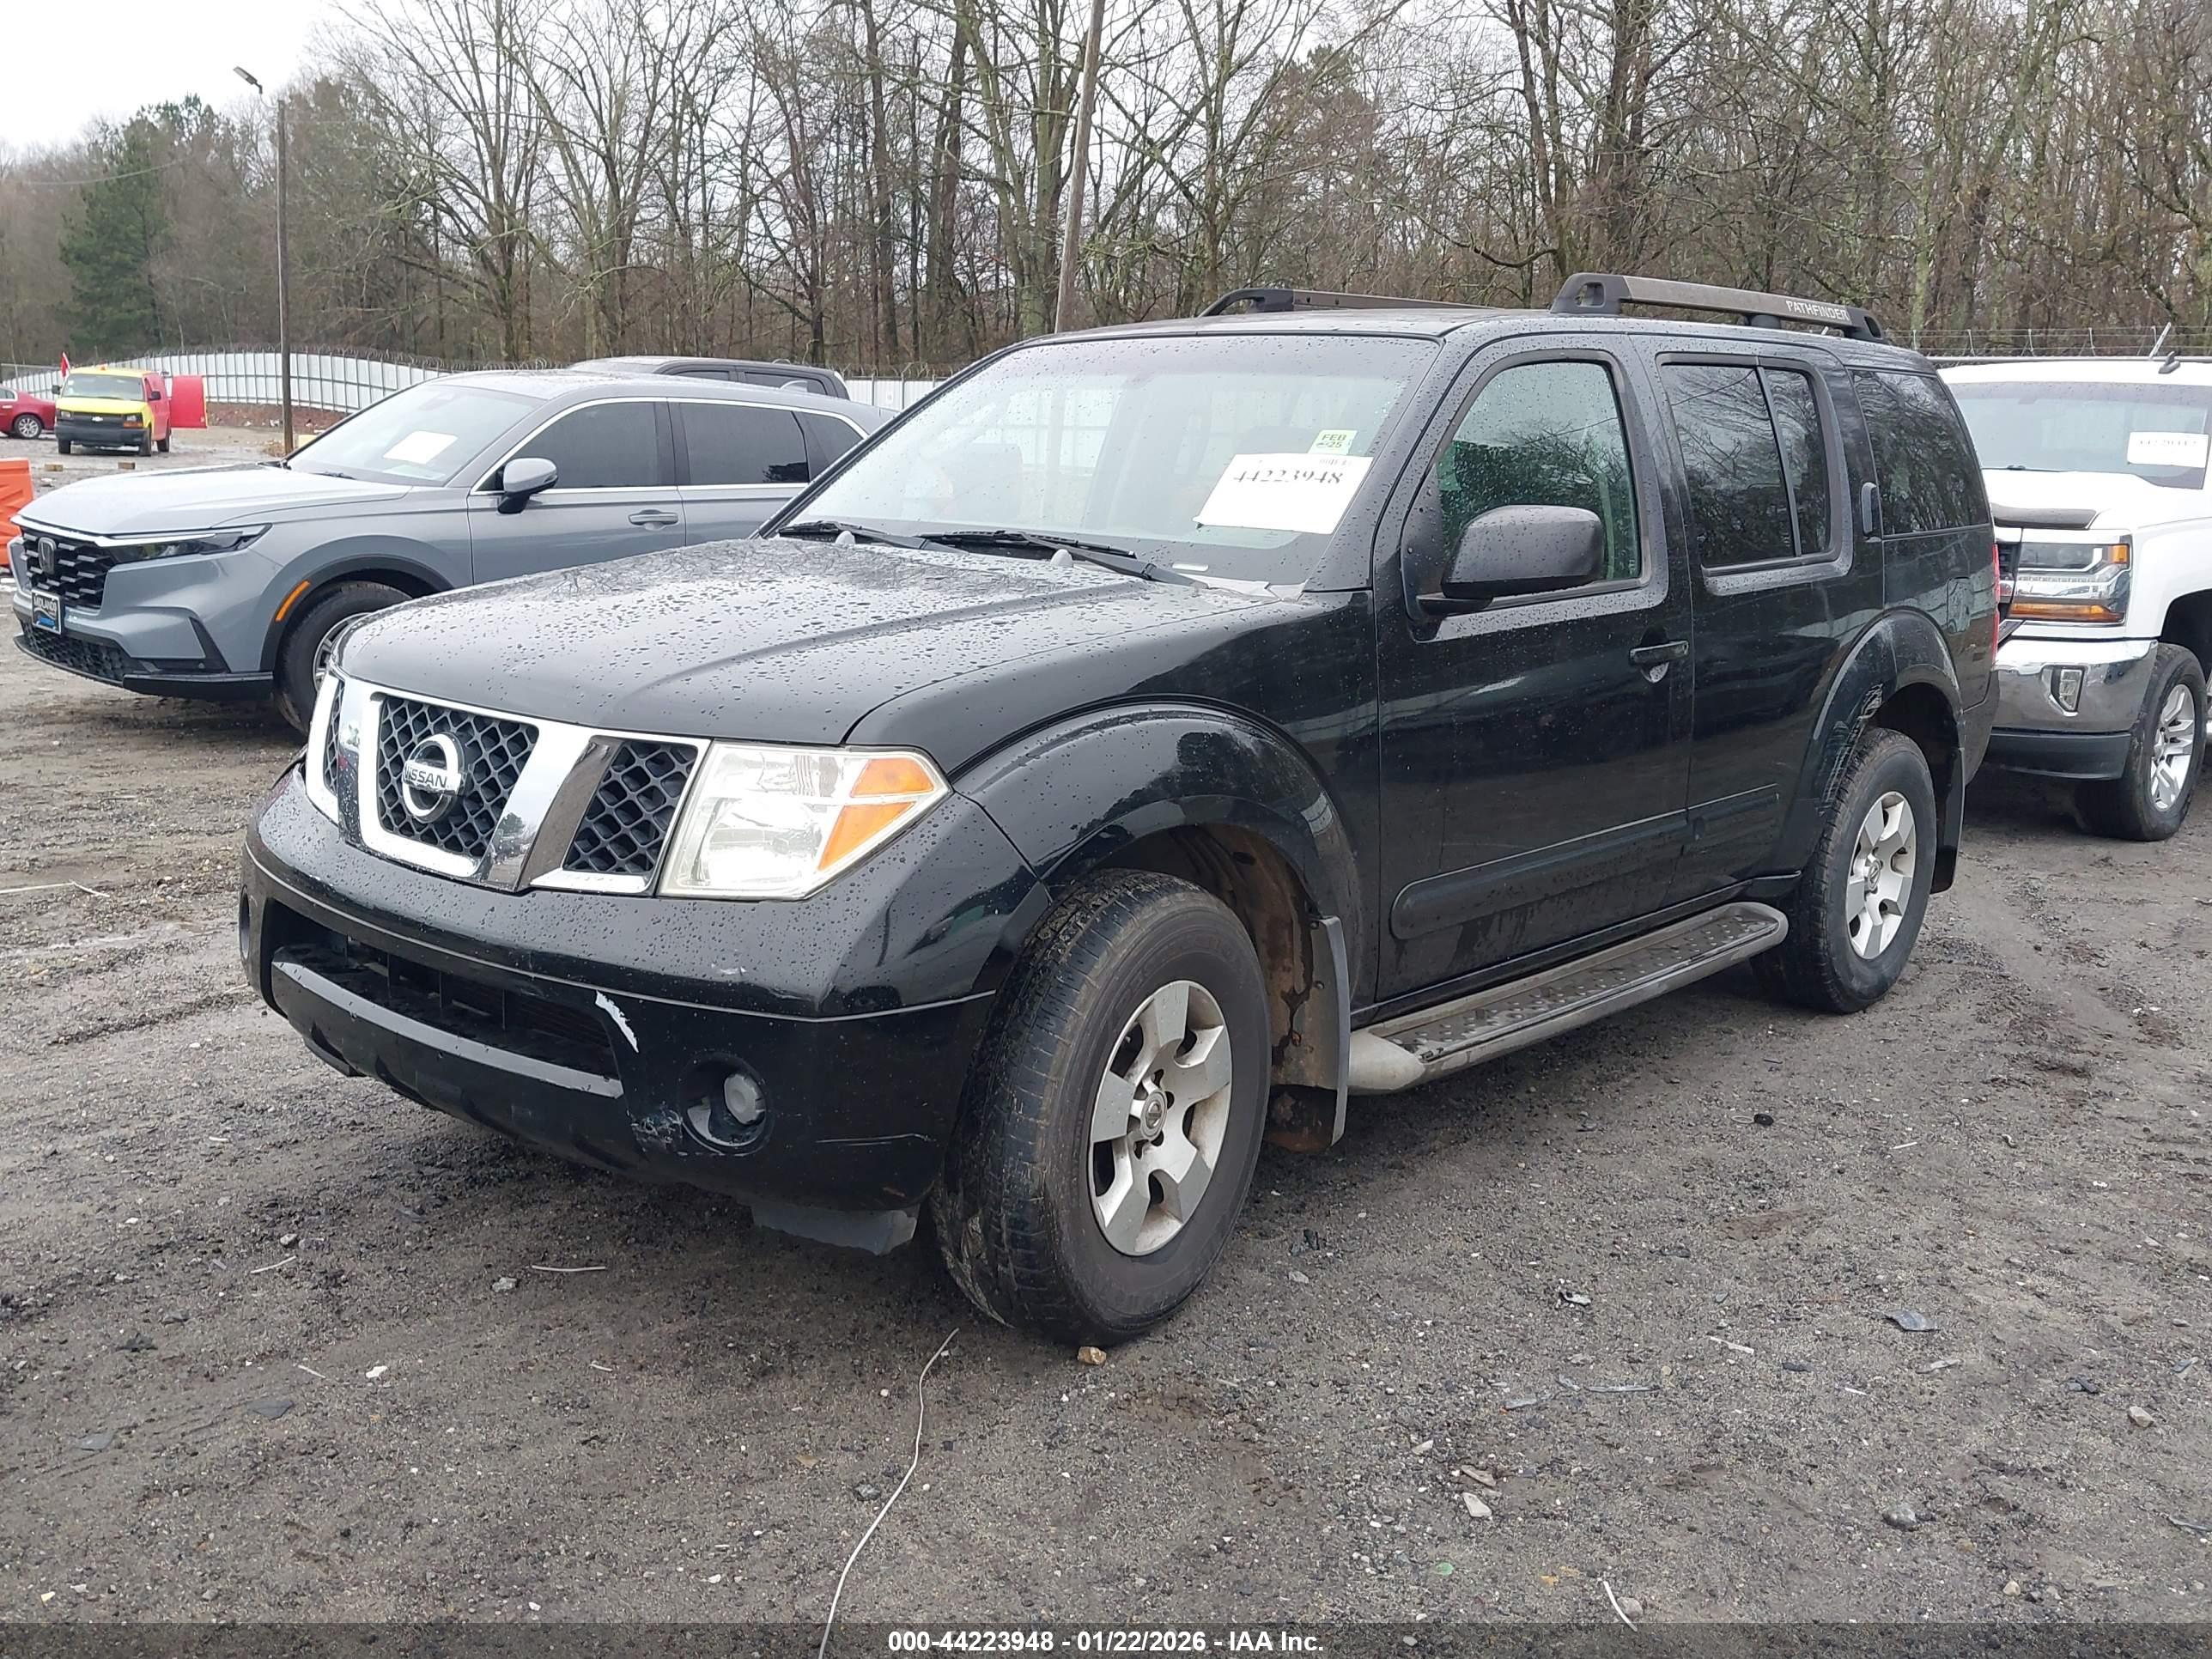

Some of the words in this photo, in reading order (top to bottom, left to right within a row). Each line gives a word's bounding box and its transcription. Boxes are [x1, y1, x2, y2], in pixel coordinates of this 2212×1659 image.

[1786, 300, 1850, 321] PATHFINDER
[1233, 470, 1344, 483] 44223948
[404, 766, 447, 788] NISSAN
